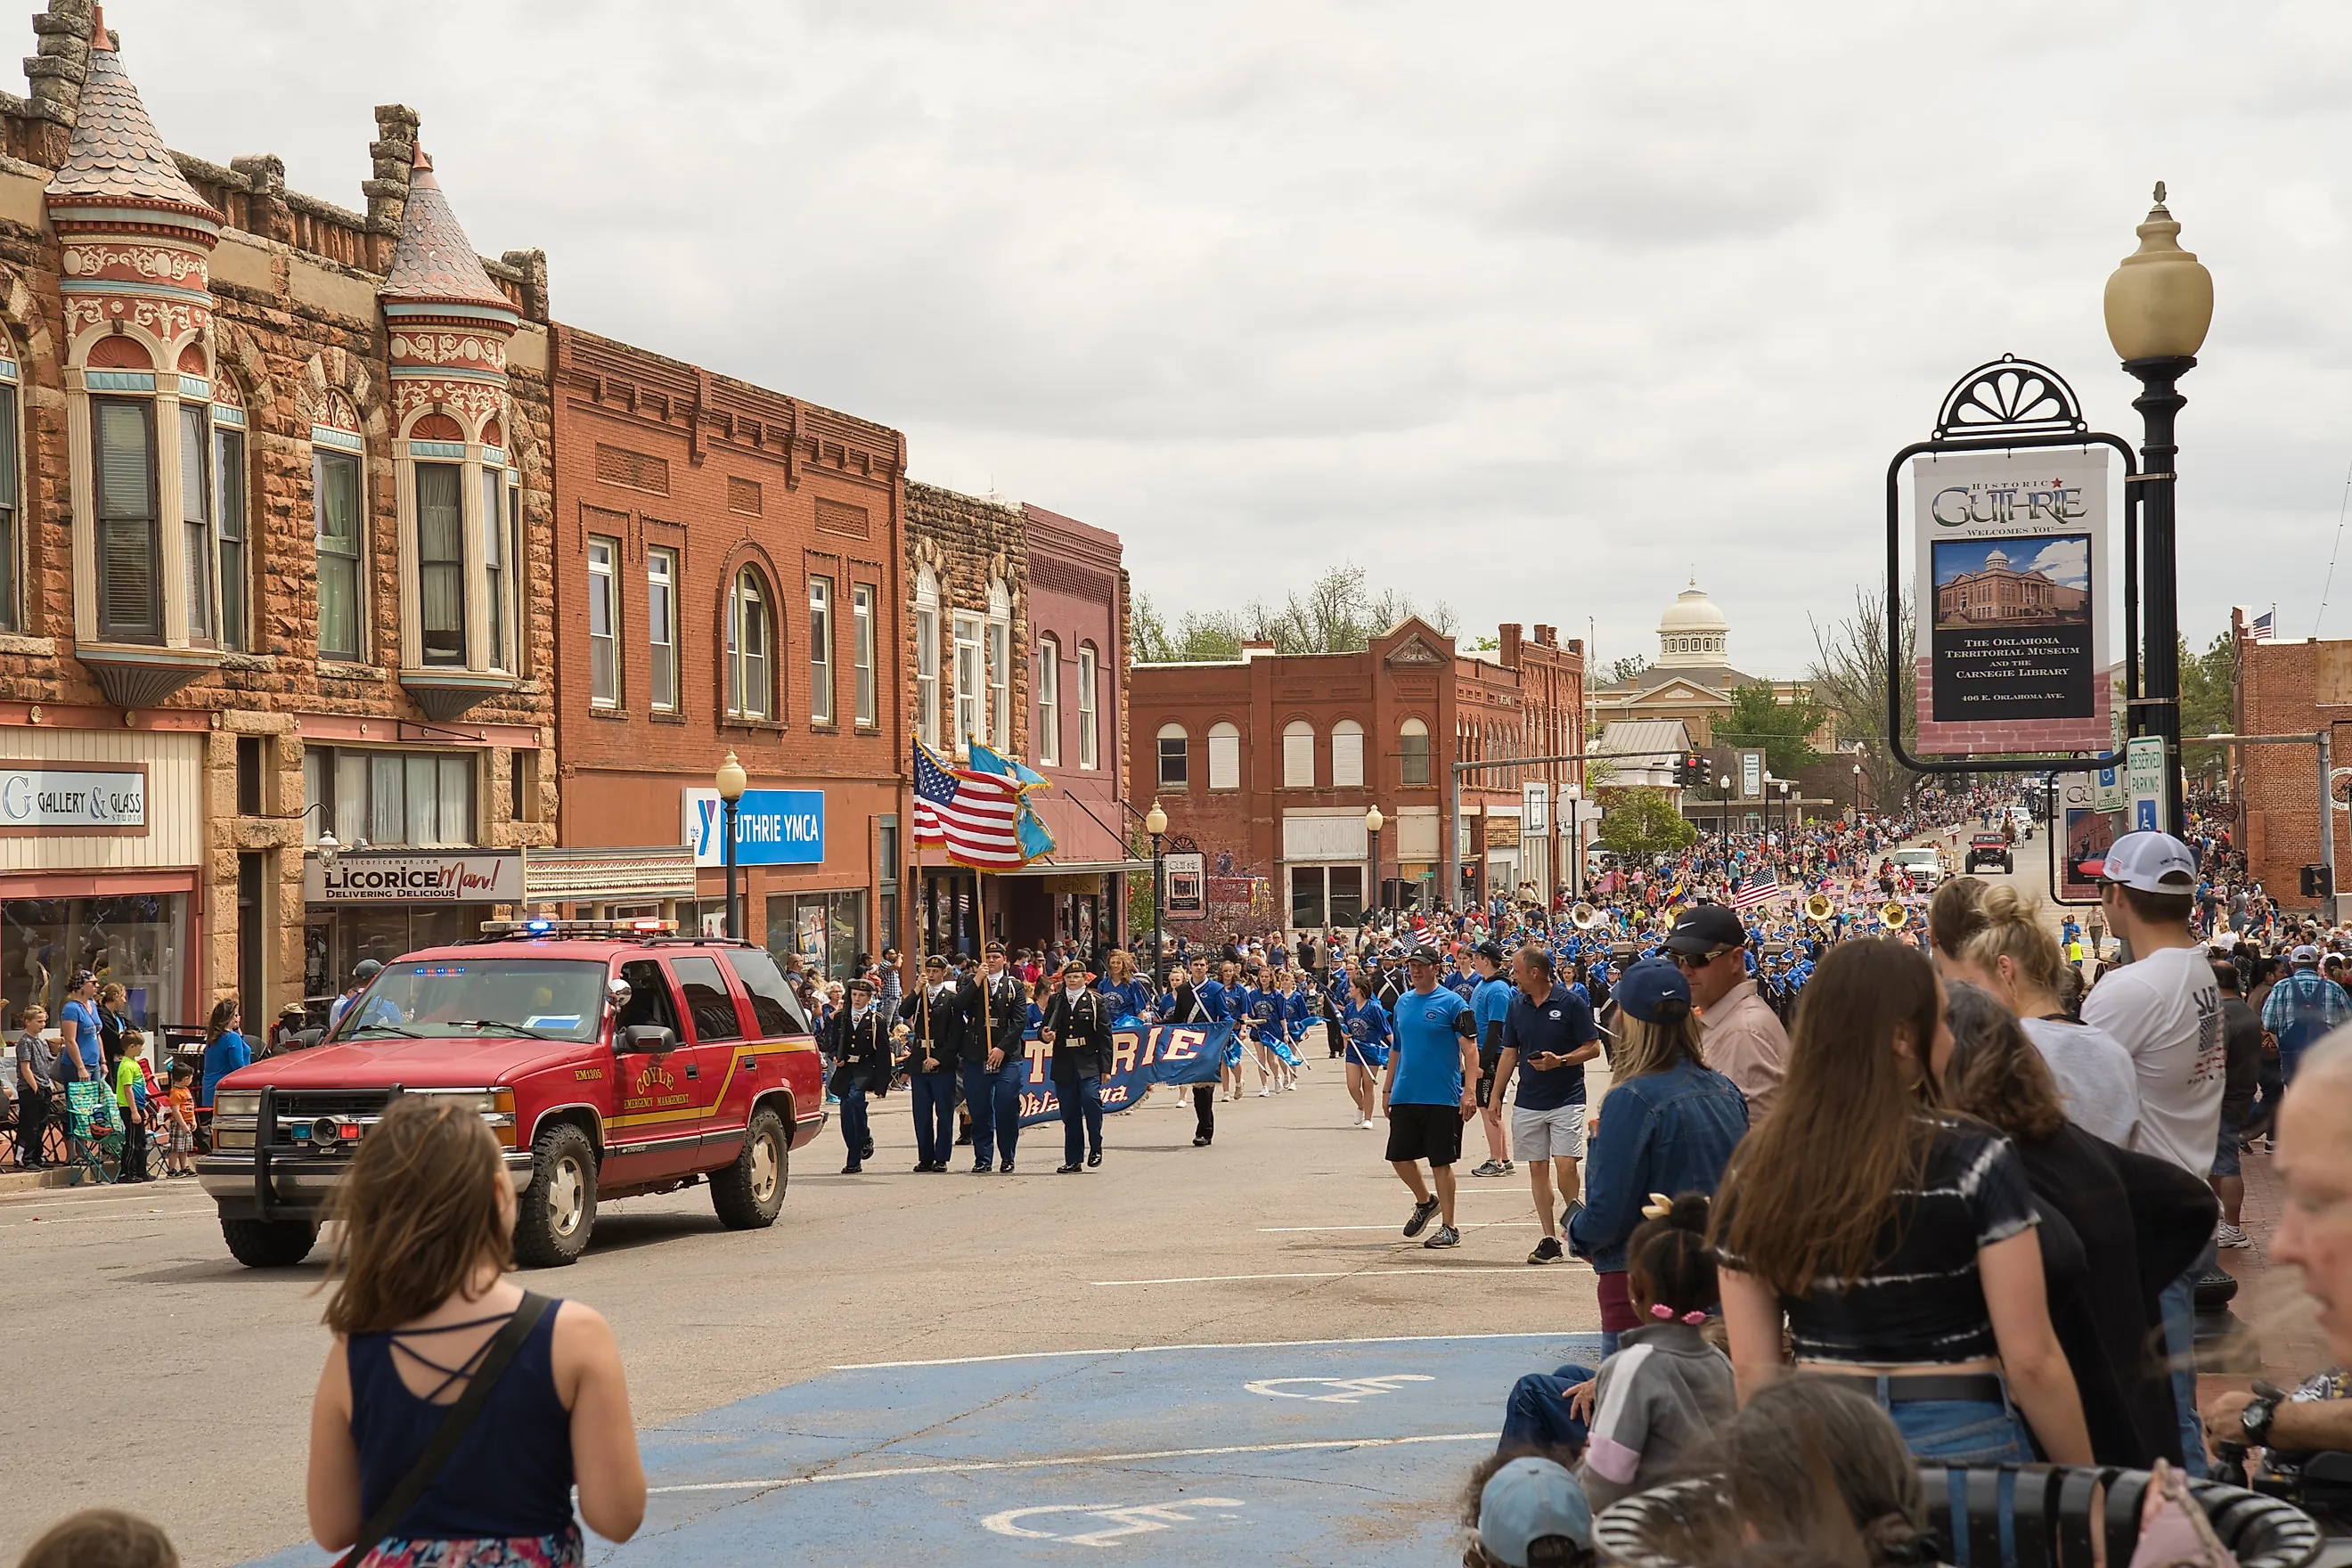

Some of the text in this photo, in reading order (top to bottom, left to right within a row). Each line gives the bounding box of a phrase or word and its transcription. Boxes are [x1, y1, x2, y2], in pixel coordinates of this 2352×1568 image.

[1972, 480, 2048, 490] HISTORIC
[1931, 486, 2088, 527] GUTHRIE
[1967, 526, 2054, 536] WELCOMES YOU
[1964, 637, 2060, 648] THE OKLAHOMA
[1945, 647, 2080, 658] TERRITORIAL MUSEUM
[1956, 668, 2070, 679] CARNEGIE LIBRARY
[1993, 693, 2043, 701] OKLAHOMA
[2045, 692, 2065, 700] AVE.
[2130, 751, 2160, 770] RESERVED
[2132, 775, 2159, 794] PARKING
[3, 775, 32, 821] G
[37, 787, 142, 820] GALLERY & GLASS
[2096, 796, 2121, 807] ACCESSIBLE
[111, 814, 143, 822] STUDIO
[727, 813, 820, 844] UTHRIE YMCA
[437, 859, 502, 899] Man!
[326, 888, 456, 898] DELIVERING DELICIOUS
[575, 1069, 602, 1081] EM1305
[636, 1066, 674, 1096] COYLE
[624, 1093, 689, 1109] EMERGENCY MANAGEMENT
